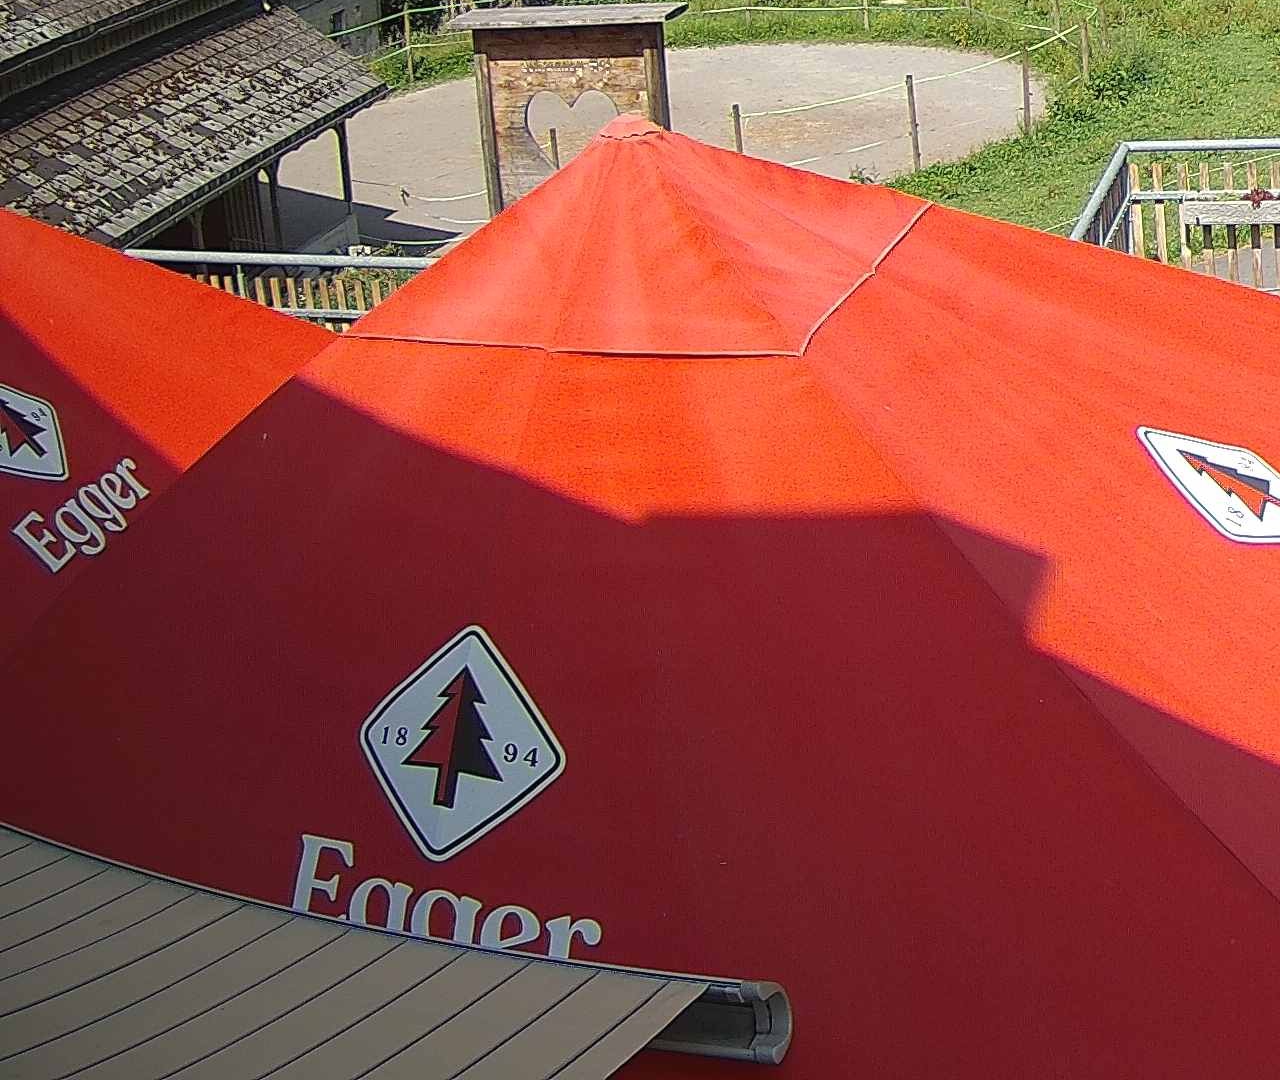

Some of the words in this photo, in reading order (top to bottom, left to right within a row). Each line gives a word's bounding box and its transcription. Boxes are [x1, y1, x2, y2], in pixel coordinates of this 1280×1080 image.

[12, 458, 151, 573] Egger
[382, 726, 409, 746] 18
[503, 743, 539, 768] 94
